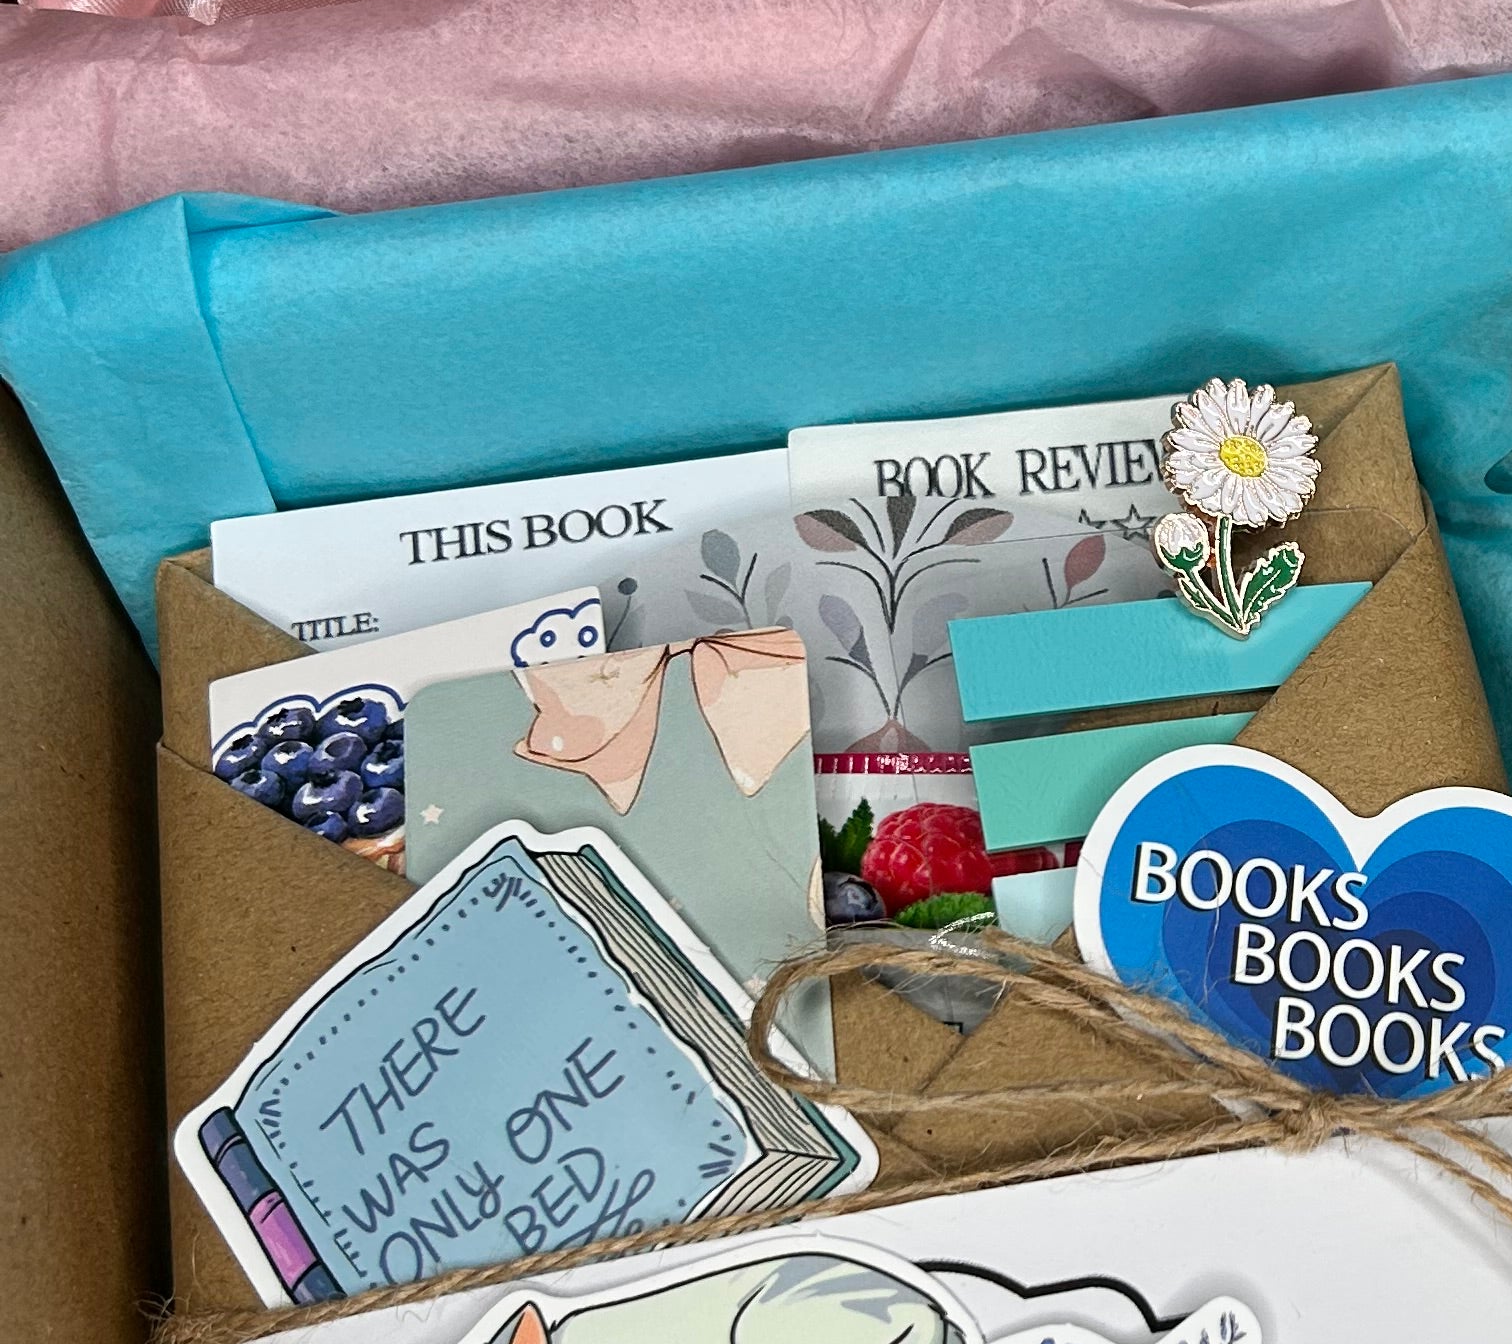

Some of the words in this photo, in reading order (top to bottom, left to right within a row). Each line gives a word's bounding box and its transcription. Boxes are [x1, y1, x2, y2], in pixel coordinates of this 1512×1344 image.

[874, 452, 995, 499] BOOK
[400, 519, 513, 566] THIS
[521, 499, 672, 551] BOOK
[291, 611, 380, 643] TITLE:
[1131, 841, 1369, 931] BOOKS
[1232, 922, 1466, 1012] BOOKS
[319, 985, 488, 1157] THERE
[1273, 996, 1506, 1084] BOOKS
[342, 1120, 451, 1234] WAS
[378, 1158, 506, 1284] ONLY
[504, 1037, 626, 1166] ONE
[503, 1146, 606, 1256] BED
